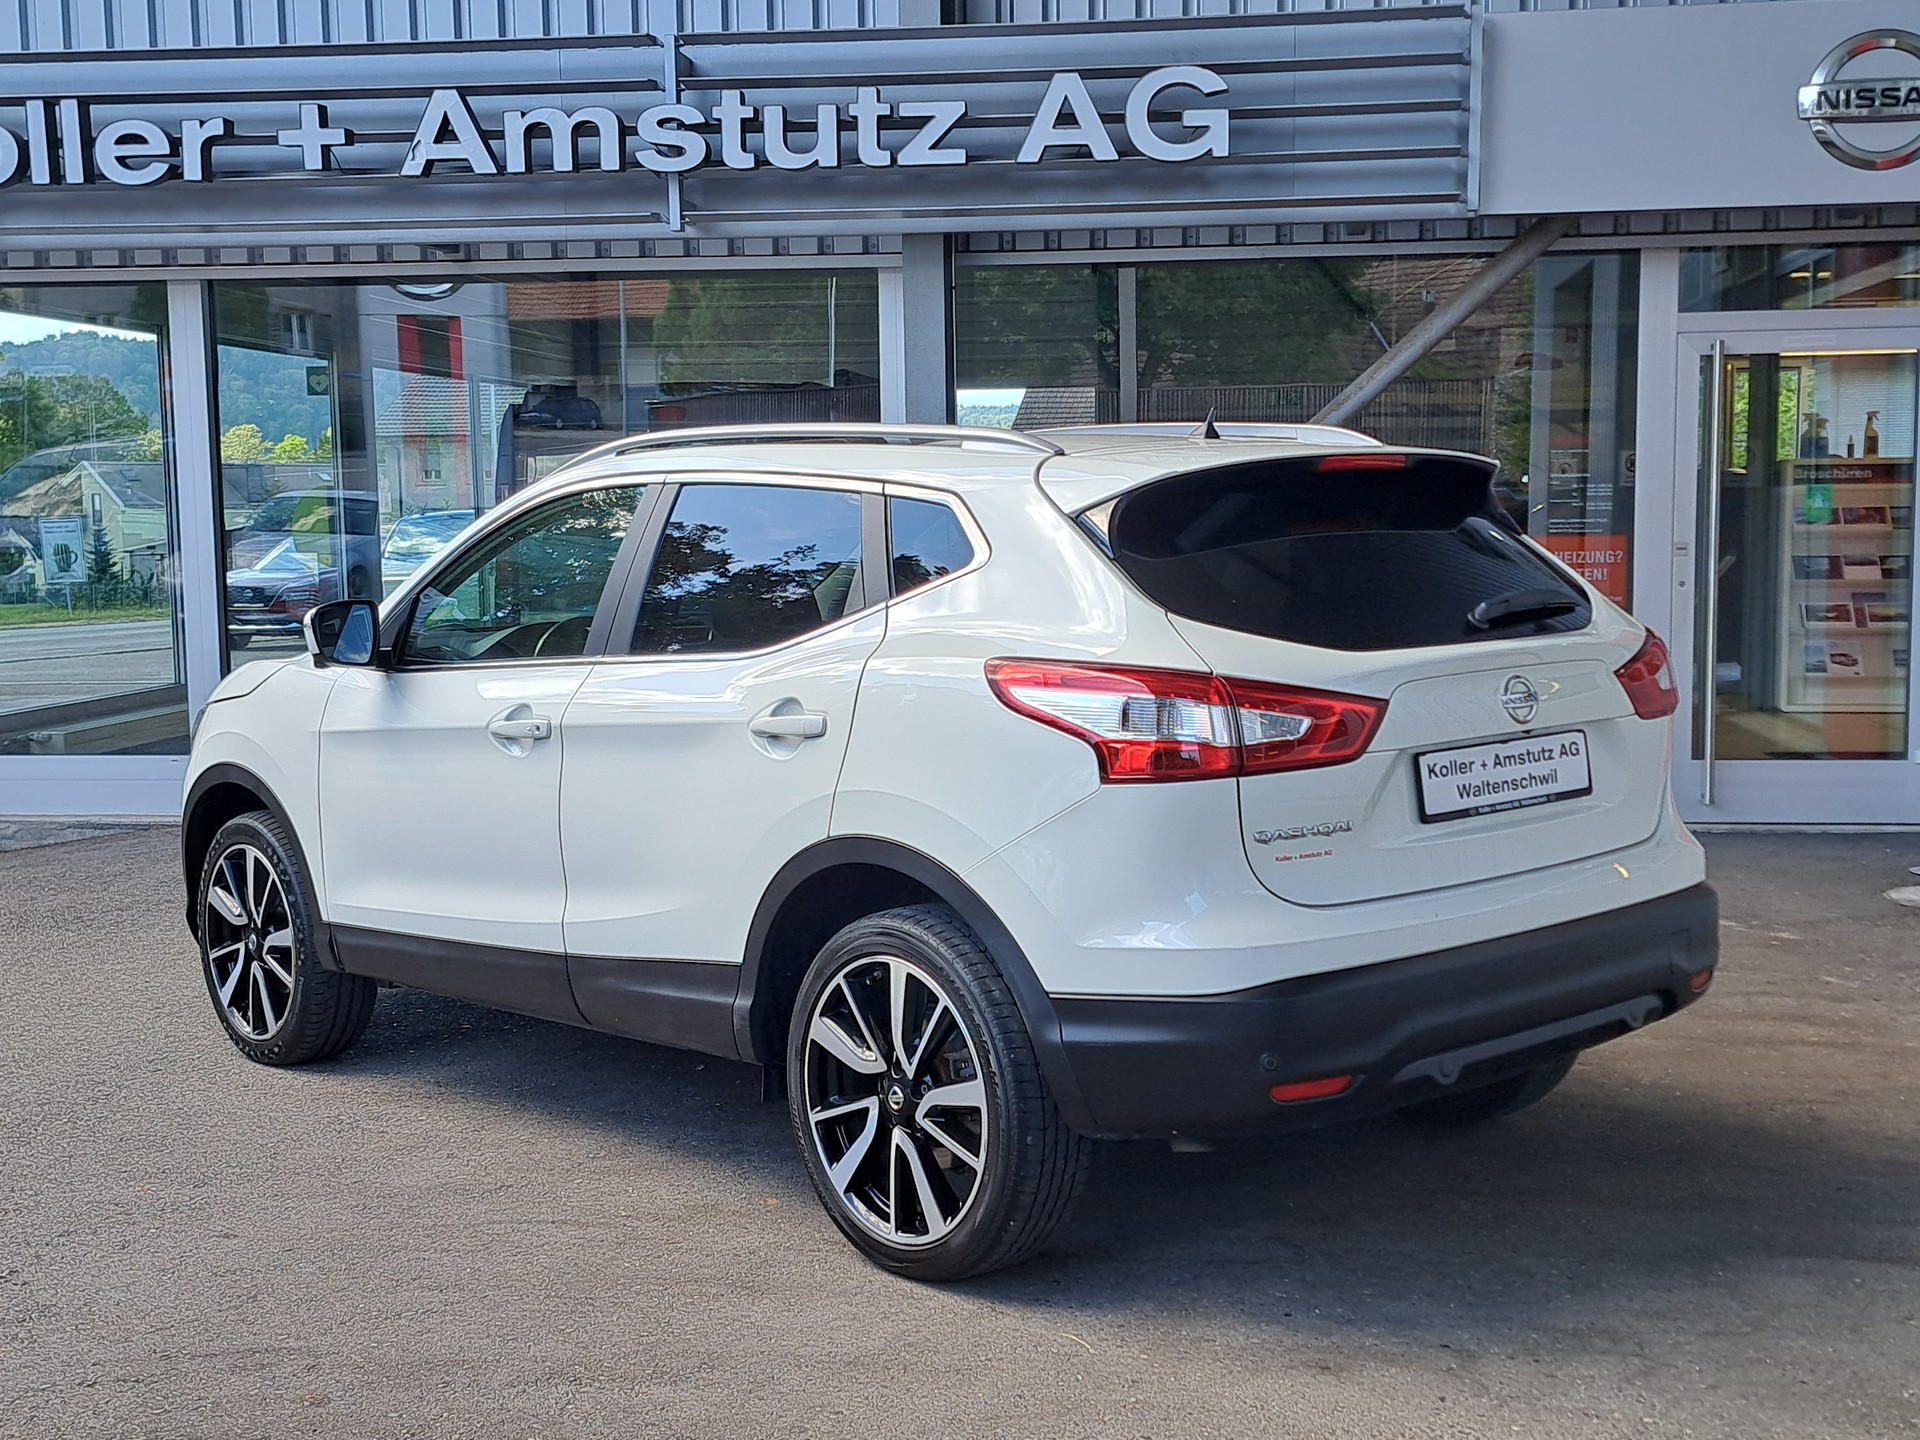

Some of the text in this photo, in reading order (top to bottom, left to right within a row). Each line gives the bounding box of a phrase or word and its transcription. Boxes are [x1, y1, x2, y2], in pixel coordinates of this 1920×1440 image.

[0, 66, 1231, 186] ller + Amstutz AG
[1426, 741, 1581, 780] Koller + Amstutz AG
[1456, 768, 1559, 800] Waltenschwil
[1253, 820, 1354, 845] QASHQAI
[1274, 854, 1294, 863] Koller
[1298, 851, 1323, 860] Amstutz
[1323, 848, 1334, 857] AG
